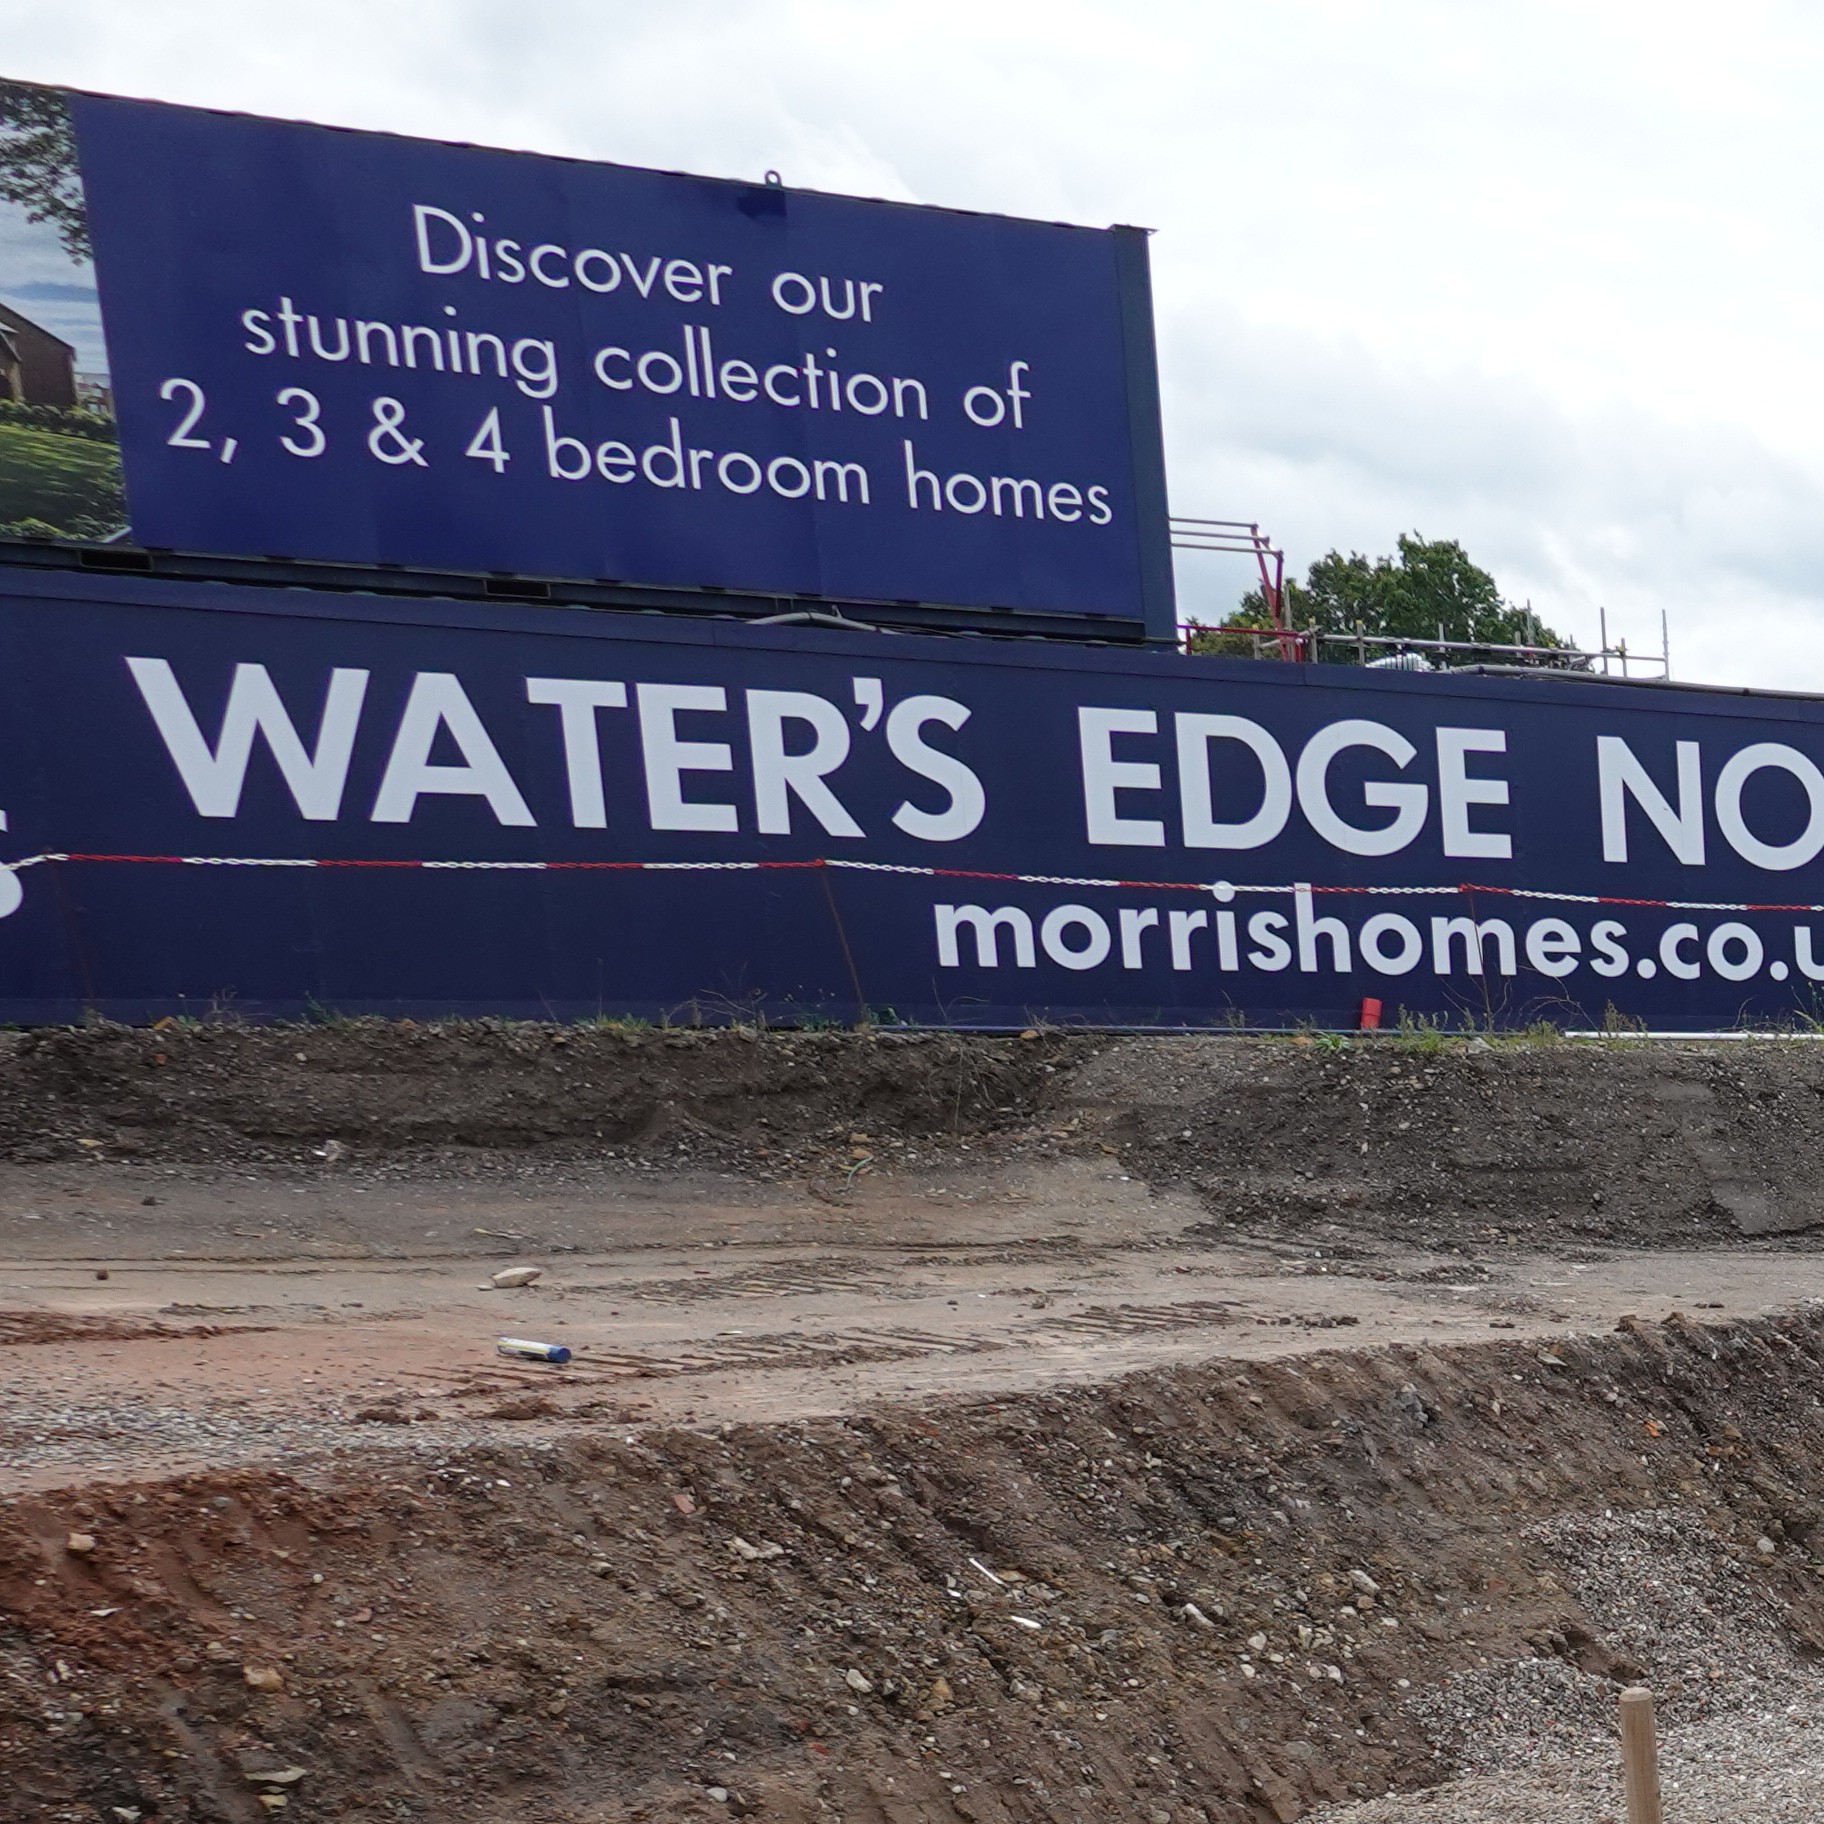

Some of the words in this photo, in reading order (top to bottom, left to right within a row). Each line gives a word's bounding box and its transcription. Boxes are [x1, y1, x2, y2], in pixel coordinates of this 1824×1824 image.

[413, 204, 733, 306] Discover
[772, 272, 884, 323] our
[242, 296, 558, 399] stunning
[594, 324, 928, 420] collection
[963, 361, 1032, 429] of
[160, 378, 238, 464] 2,
[277, 387, 326, 457] 3
[368, 396, 429, 467] &
[465, 406, 510, 473] 4
[542, 405, 870, 504] bedroom
[904, 439, 1112, 525] homes
[124, 656, 986, 842] WATER'S
[1077, 706, 1513, 859] EDGE
